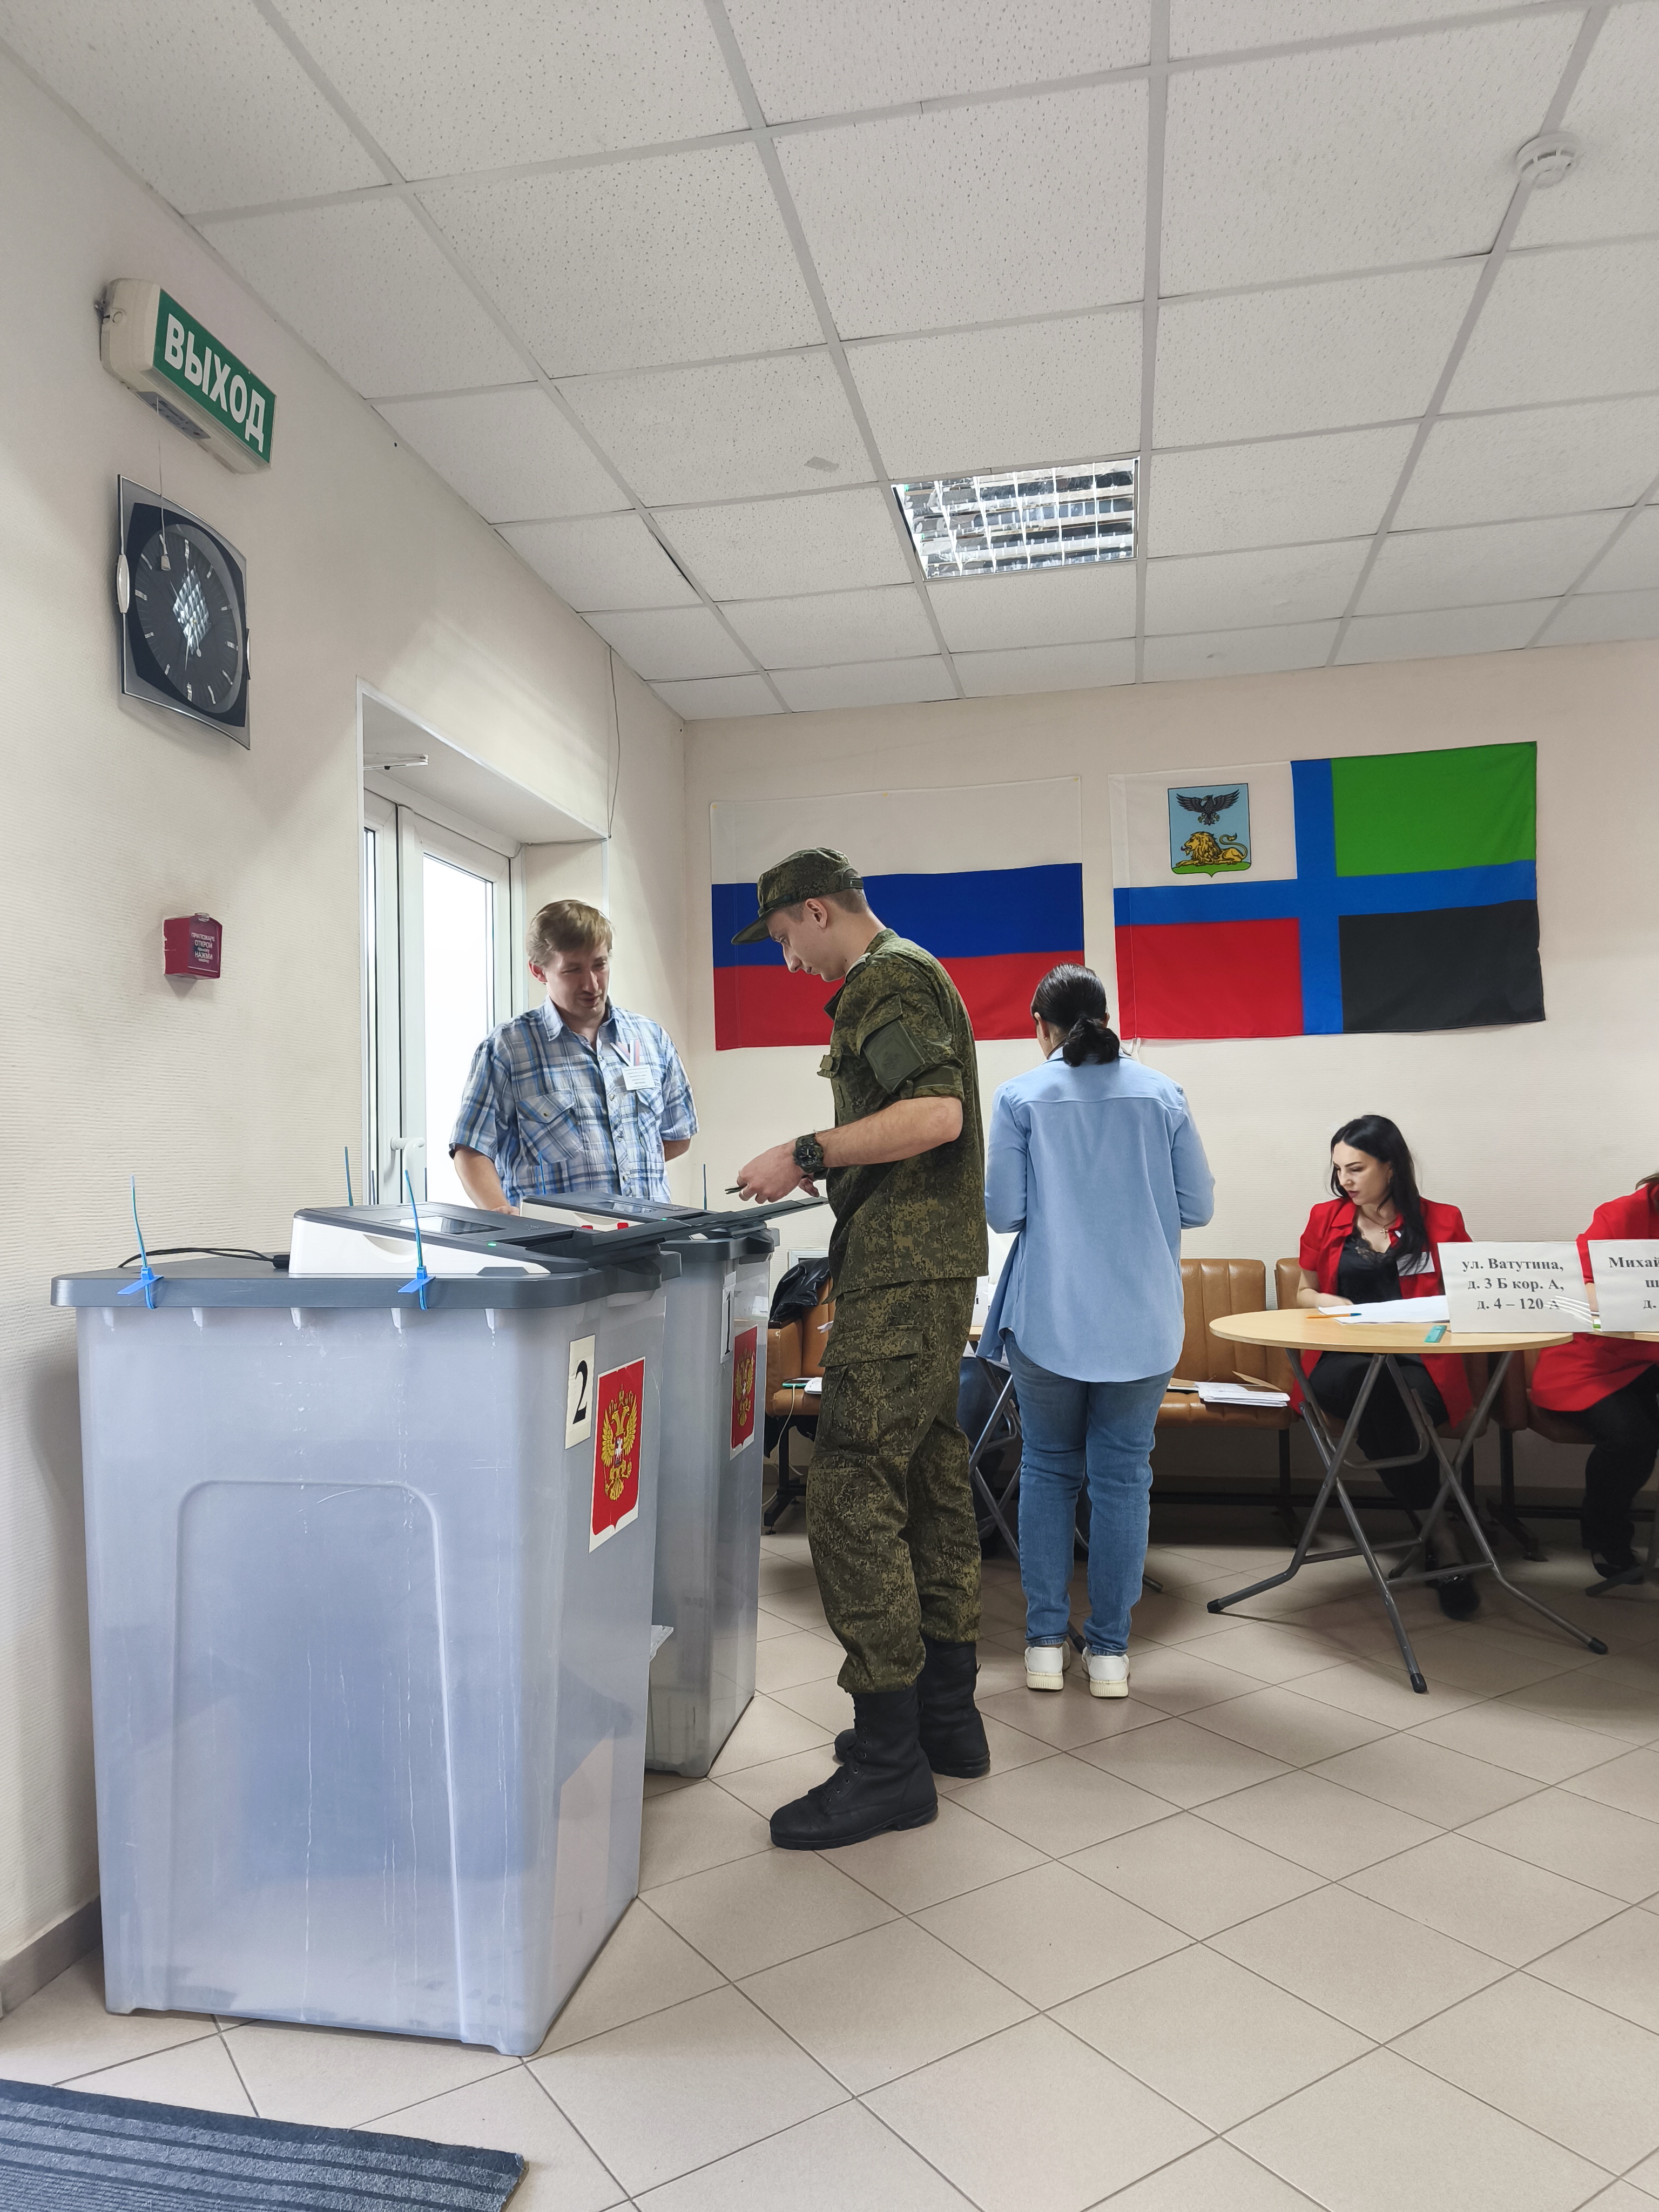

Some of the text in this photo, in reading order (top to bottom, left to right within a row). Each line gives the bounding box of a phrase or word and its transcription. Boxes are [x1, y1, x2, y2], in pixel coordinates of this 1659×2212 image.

[165, 313, 266, 453] ВЫХОД
[1461, 1258, 1563, 1272] ул. Ватутина,
[1468, 1278, 1564, 1292] д. 3 Б кор. А,
[1477, 1300, 1489, 1310] д.
[1494, 1298, 1502, 1309] 4
[1520, 1298, 1544, 1310] 120
[1643, 1300, 1656, 1310] д.
[572, 1360, 588, 1425] 2
